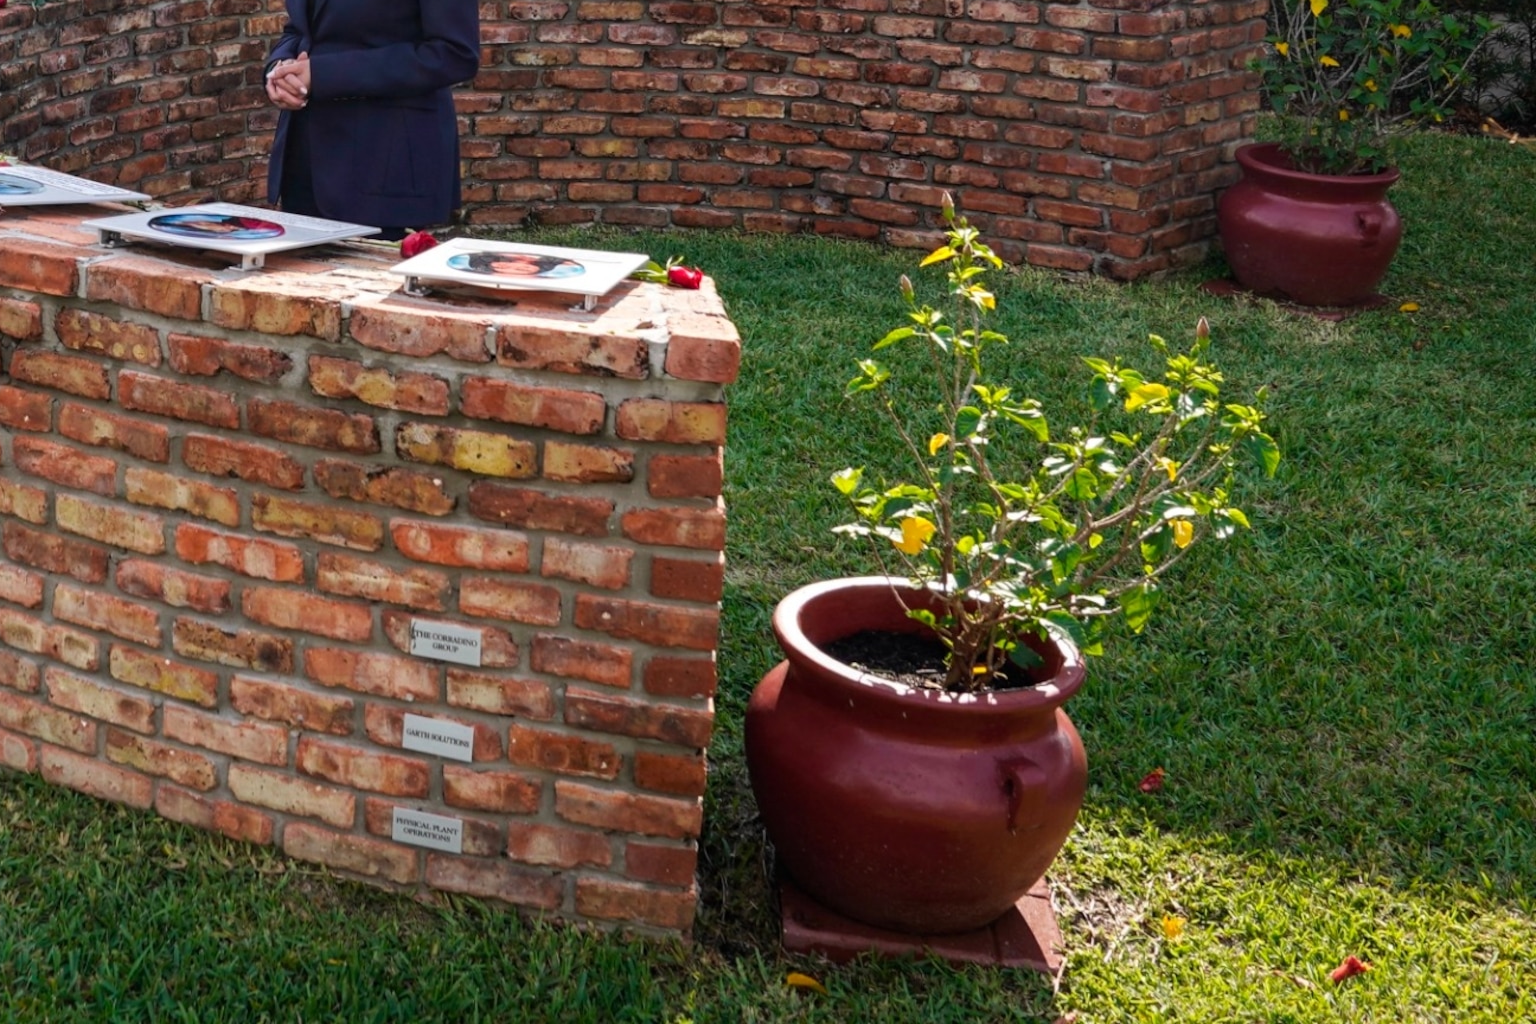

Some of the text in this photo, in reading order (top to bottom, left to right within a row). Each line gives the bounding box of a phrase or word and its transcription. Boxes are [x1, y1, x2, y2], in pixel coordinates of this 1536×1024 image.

[415, 629, 478, 648] THE CORRADINO
[432, 641, 459, 653] GROUP
[406, 727, 470, 748] GARTH SOLUTIONS
[396, 817, 458, 837] PHYSICAL PLANT
[402, 826, 451, 843] OPERATIONS
